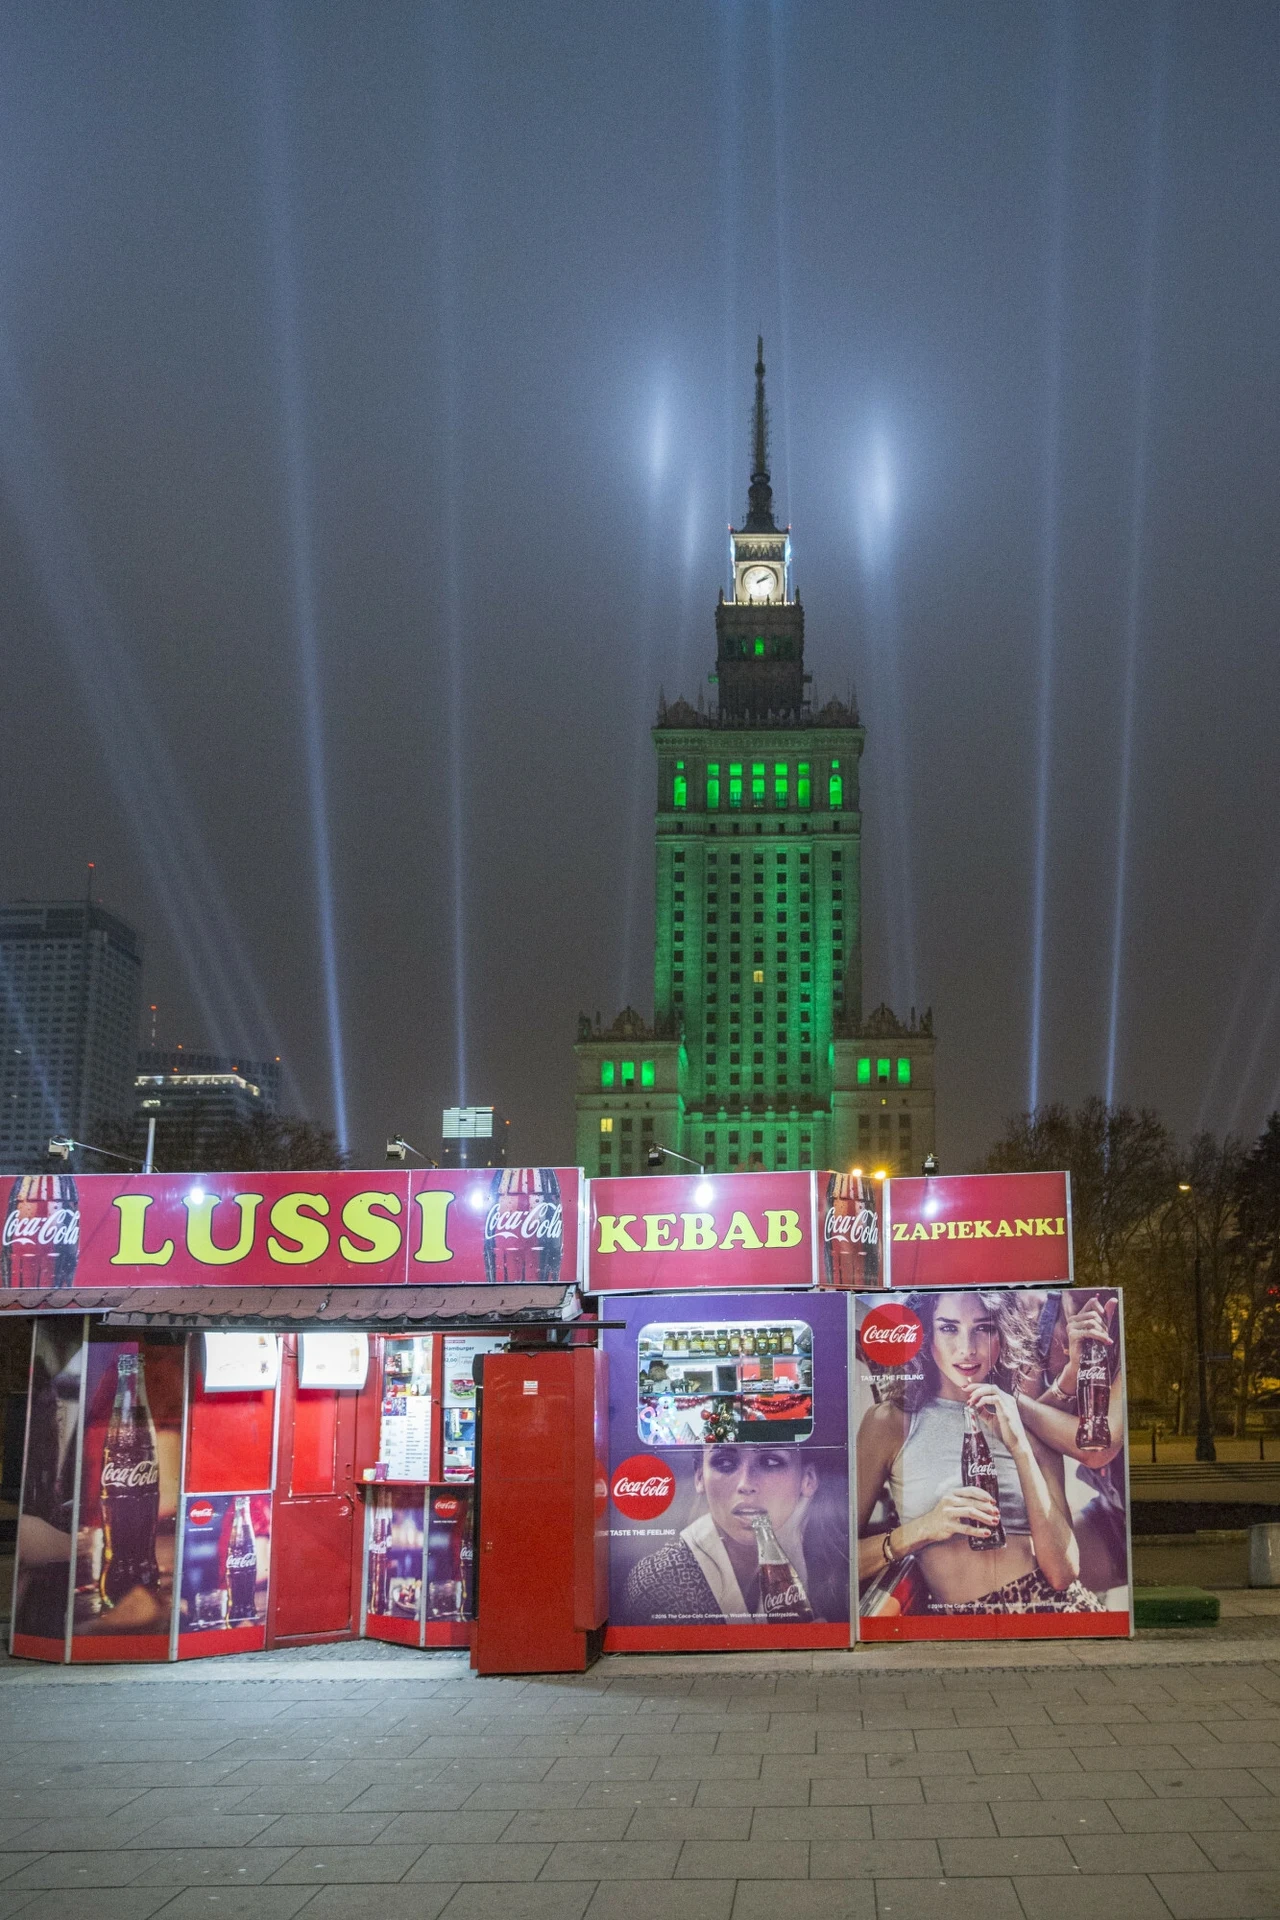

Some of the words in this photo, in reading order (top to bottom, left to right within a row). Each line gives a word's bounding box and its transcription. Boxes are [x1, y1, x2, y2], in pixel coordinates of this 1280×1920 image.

[2, 1209, 80, 1246] Coca-Cola
[109, 1190, 456, 1266] LUSSI
[485, 1202, 563, 1240] Coca-Cola
[597, 1208, 803, 1254] KEBAB
[824, 1206, 878, 1245] Coca-Cola
[892, 1217, 1065, 1241] ZAPIEKANKI
[863, 1324, 920, 1344] Coca-Cola
[101, 1460, 158, 1487] Coca-Cola
[613, 1476, 673, 1497] Coca-Cola
[646, 1528, 675, 1536] FEELING
